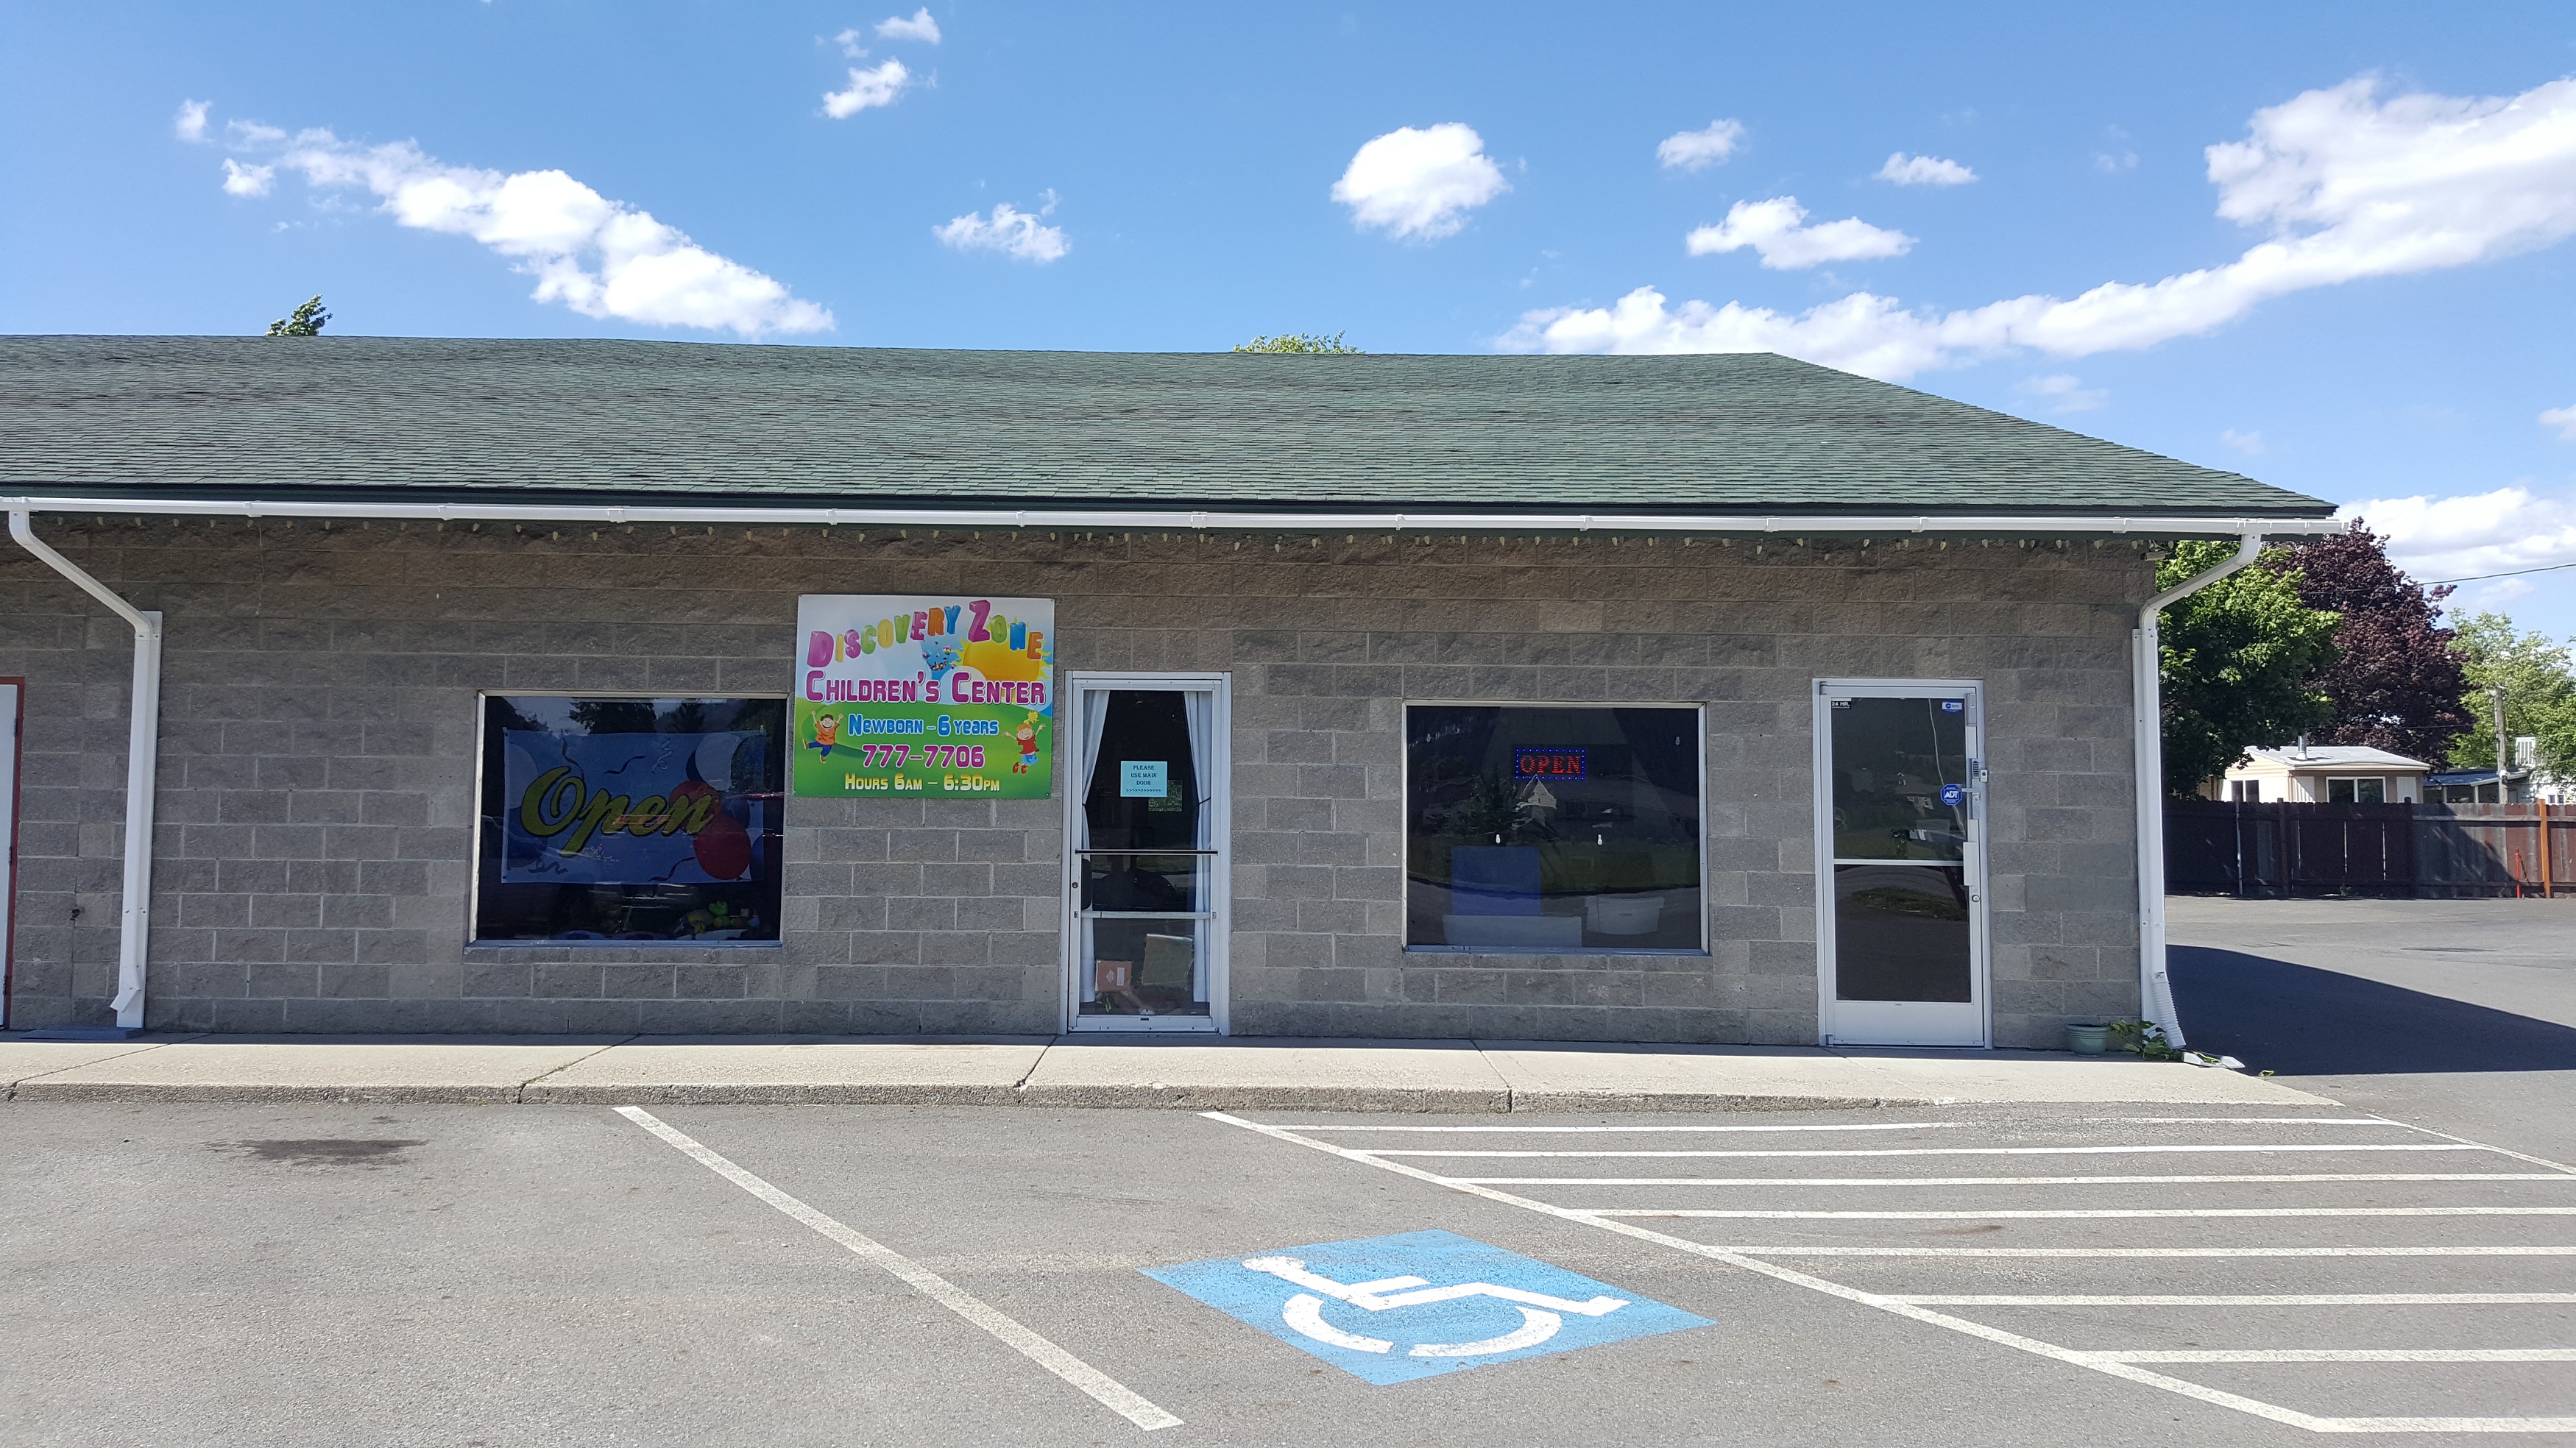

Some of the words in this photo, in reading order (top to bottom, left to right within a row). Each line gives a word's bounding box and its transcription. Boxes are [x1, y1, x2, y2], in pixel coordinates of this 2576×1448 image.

[807, 605, 961, 667] DISCOVERY
[968, 600, 1044, 660] ZONE
[806, 670, 941, 703] CHILDREN'S
[952, 671, 1046, 704] CENTER
[937, 715, 951, 737] 6
[862, 744, 986, 768] 777-7706
[1520, 755, 1582, 774] OPEN
[845, 773, 888, 790] HOURS
[894, 773, 923, 791] 6AM
[944, 774, 1000, 792] 6:30PM
[1944, 790, 1959, 798] ADT
[520, 766, 715, 857] Open
